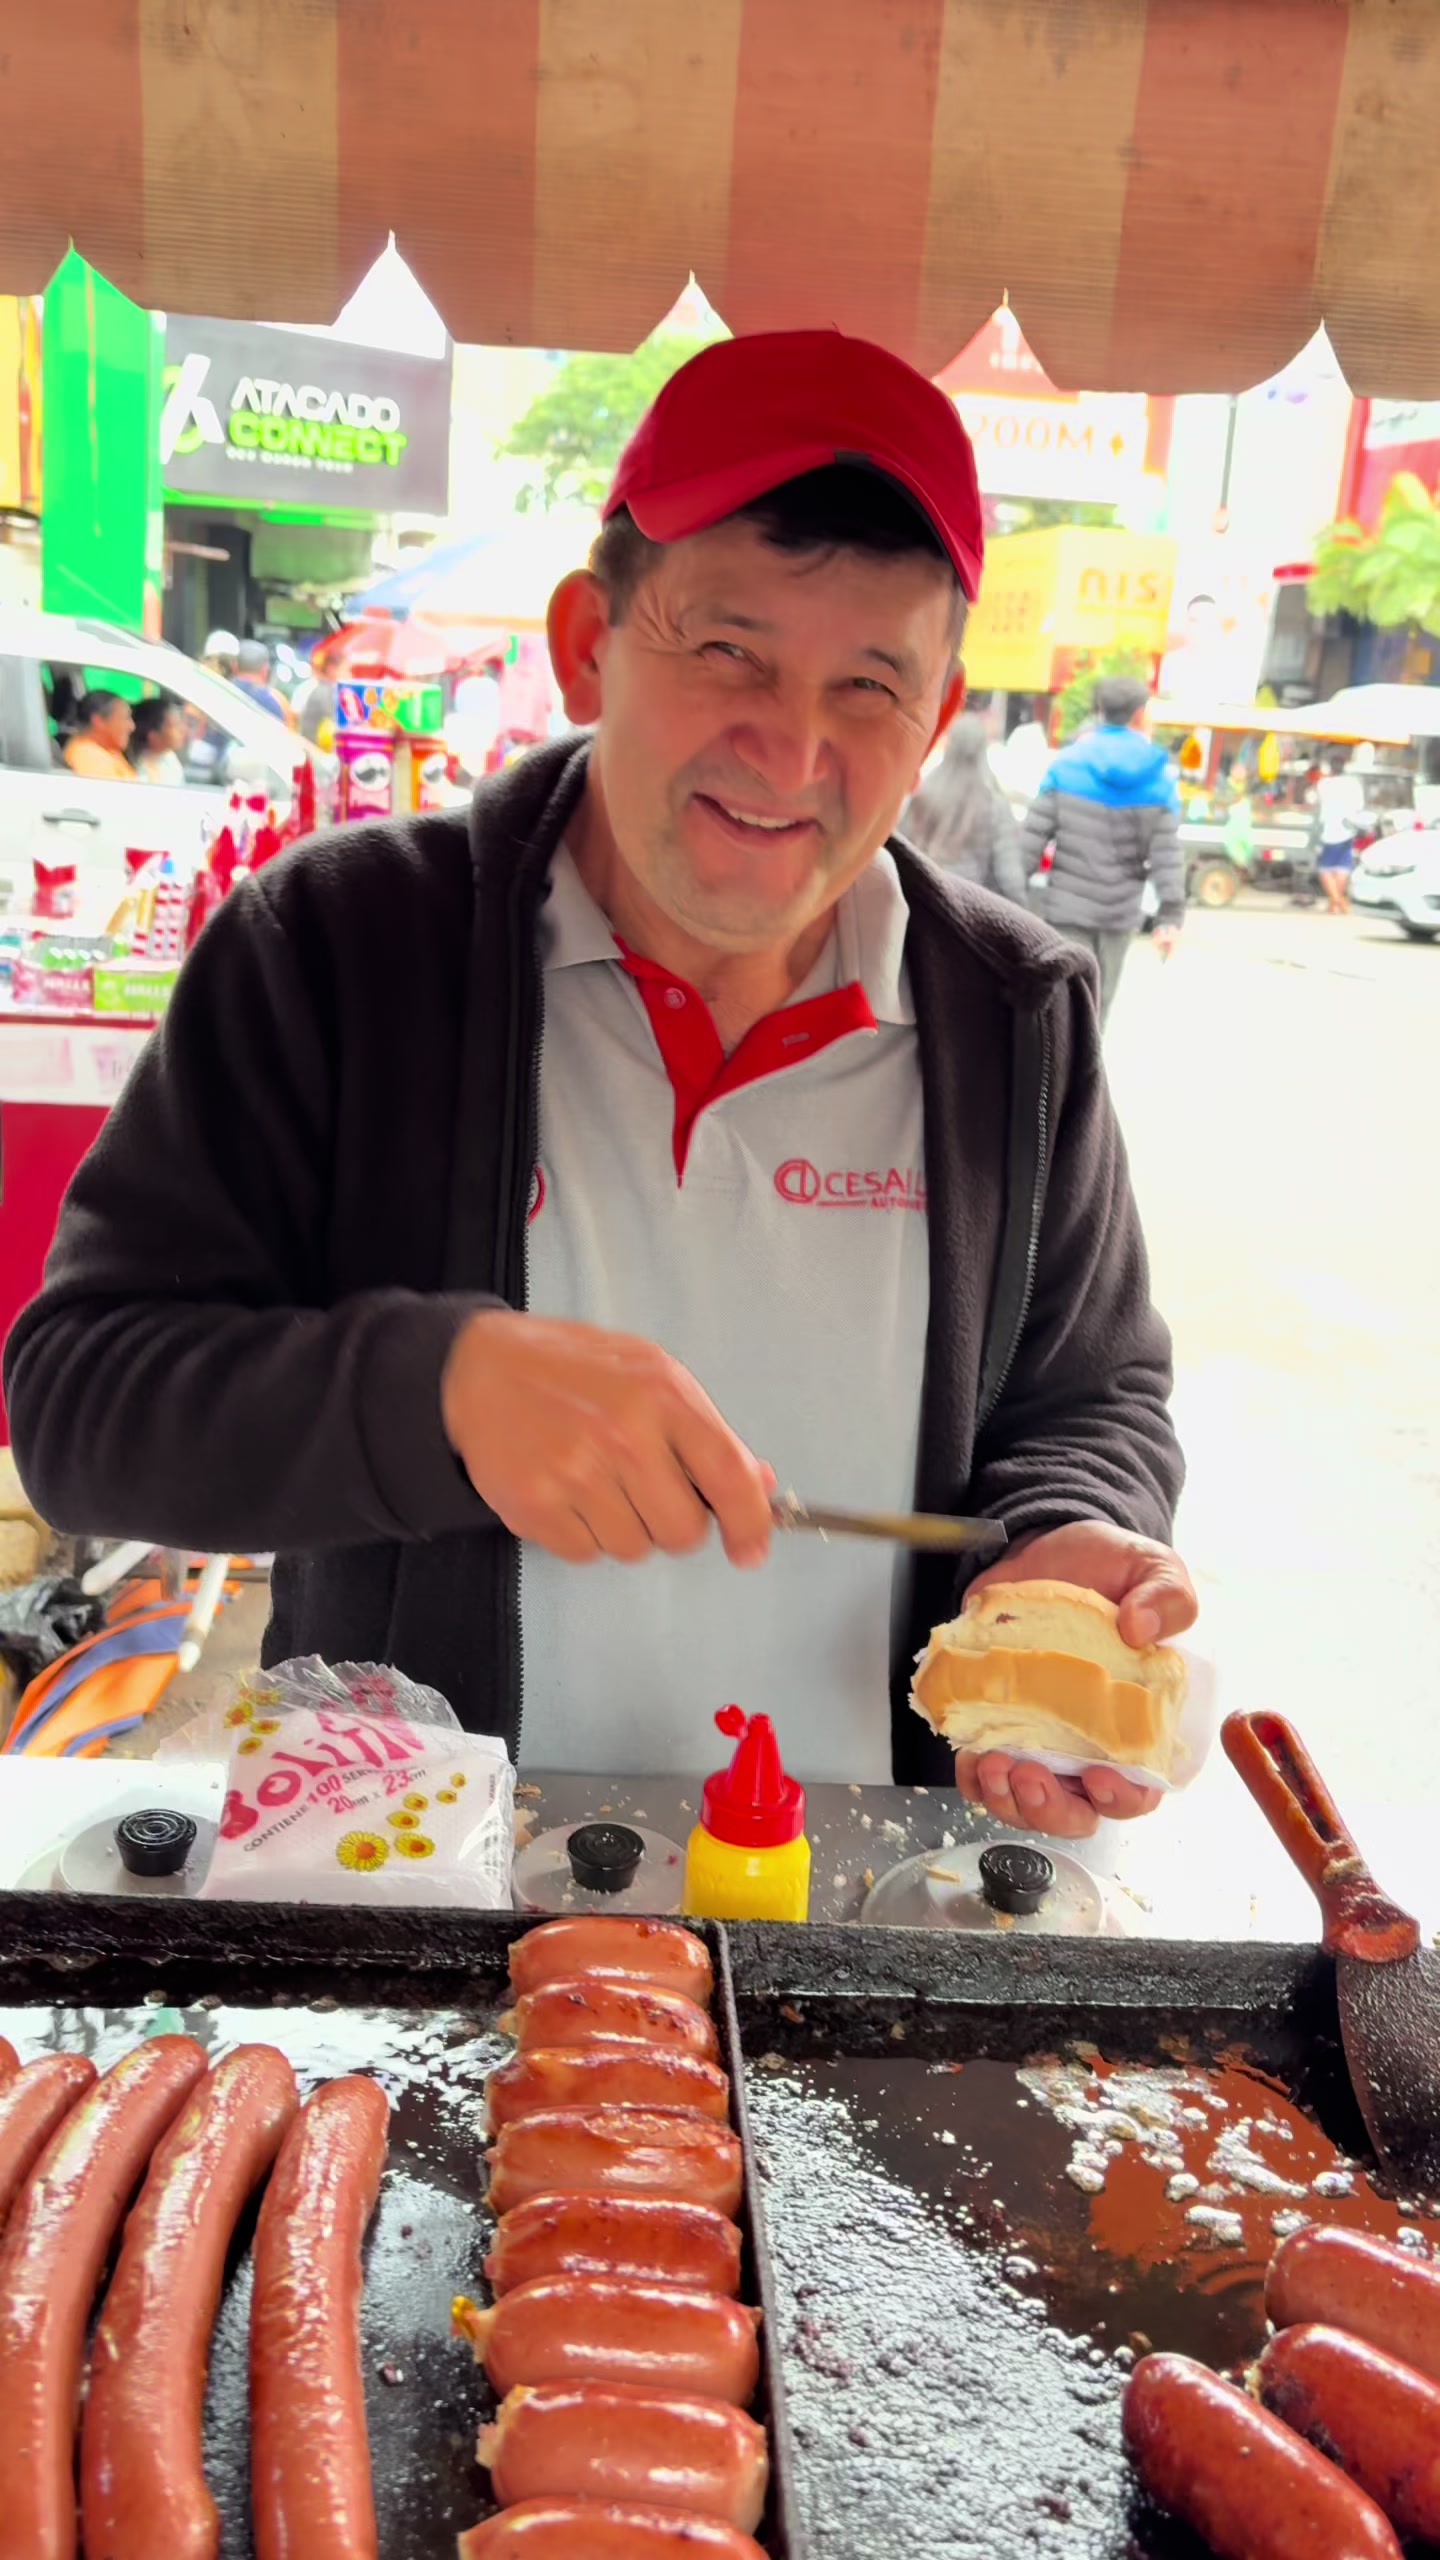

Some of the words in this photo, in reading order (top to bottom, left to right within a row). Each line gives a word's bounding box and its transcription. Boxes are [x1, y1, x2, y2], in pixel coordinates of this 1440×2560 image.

[231, 376, 400, 433] ATACADO
[229, 410, 407, 467] CONNECT
[243, 1804, 308, 1852] CONTIENE
[308, 1774, 342, 1804] 100
